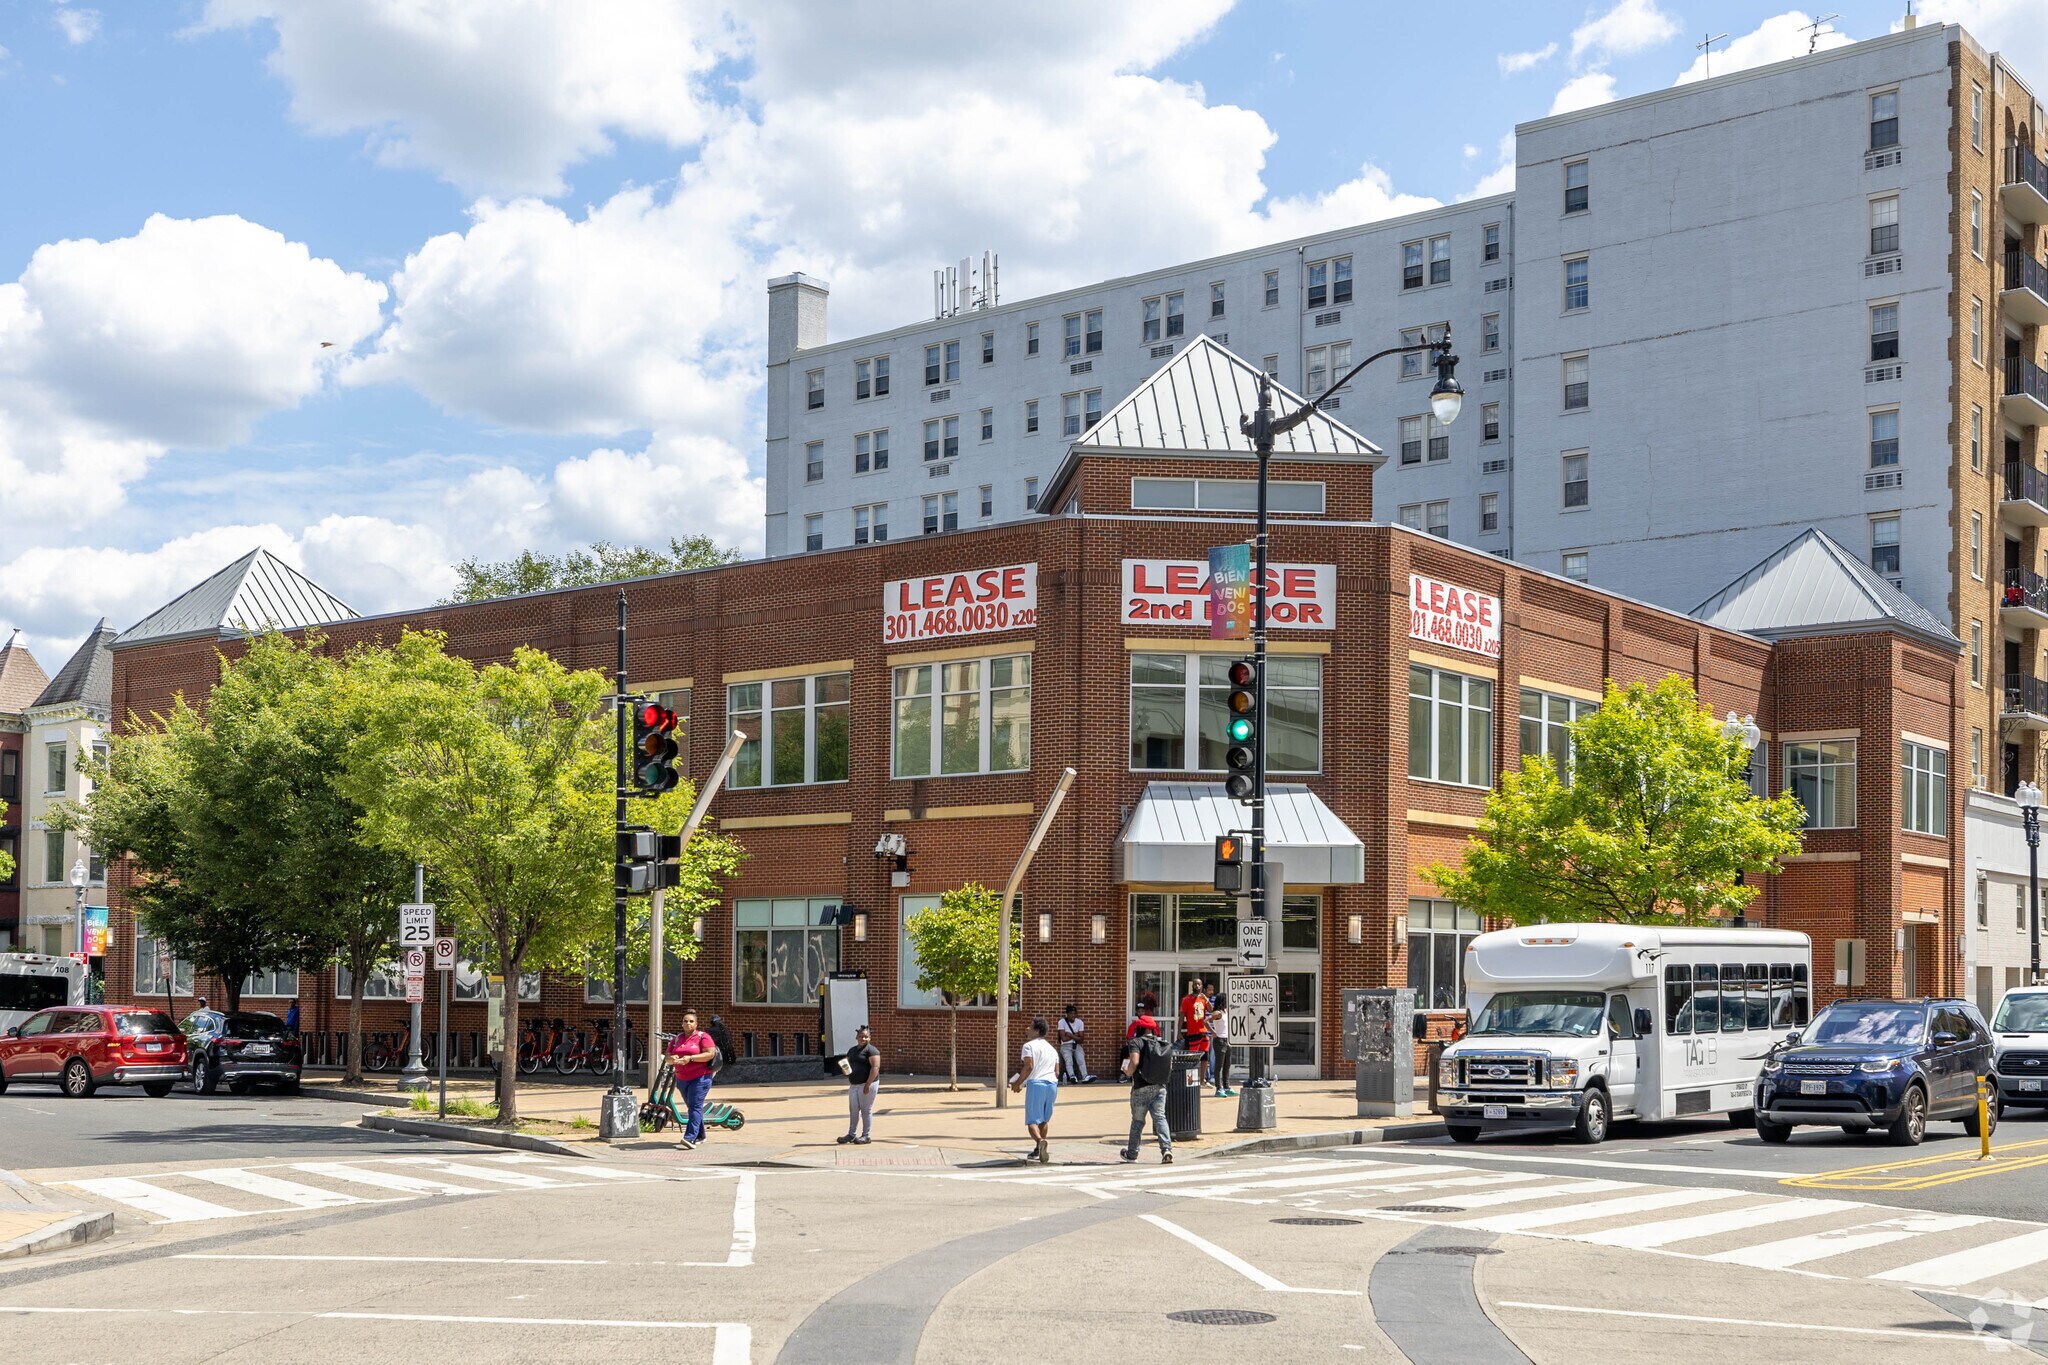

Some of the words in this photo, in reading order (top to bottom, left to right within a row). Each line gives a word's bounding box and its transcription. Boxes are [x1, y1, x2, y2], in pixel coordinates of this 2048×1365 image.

[1133, 564, 1316, 599] LESE
[1213, 570, 1245, 584] BIEN
[900, 567, 1025, 612] LEASE
[1215, 587, 1246, 600] VENI
[1128, 598, 1192, 619] 2nd
[1217, 601, 1245, 616] DOS
[1415, 577, 1492, 627] LEASE
[885, 602, 1008, 640] 301.468.0030
[403, 908, 431, 916] SPEED
[87, 919, 105, 928] BIEN
[404, 926, 430, 941] 25
[1242, 926, 1263, 936] ONE
[87, 936, 104, 944] DOS
[1243, 938, 1262, 948] WAY
[1645, 963, 1655, 974] 117
[1231, 980, 1272, 990] DIAGONAL
[1231, 993, 1273, 1003] CROSSING
[1230, 1015, 1246, 1037] OK
